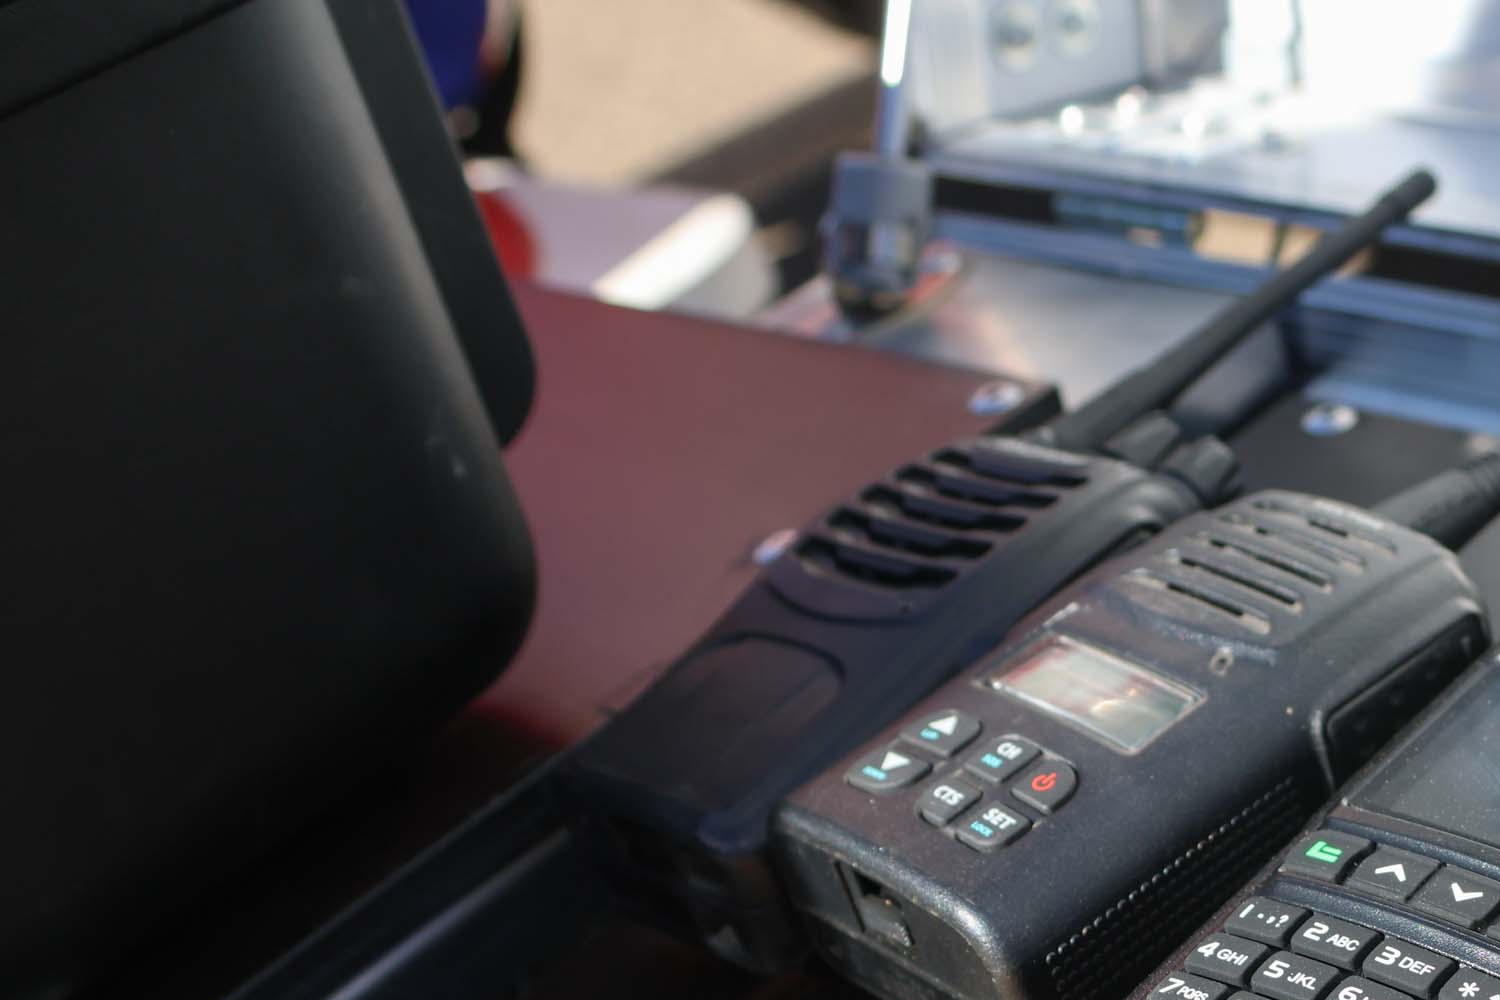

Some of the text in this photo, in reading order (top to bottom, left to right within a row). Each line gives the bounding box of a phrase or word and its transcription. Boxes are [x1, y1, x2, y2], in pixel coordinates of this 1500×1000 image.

[997, 742, 1023, 760] CH
[933, 785, 965, 805] CTS
[982, 808, 1016, 829] SET
